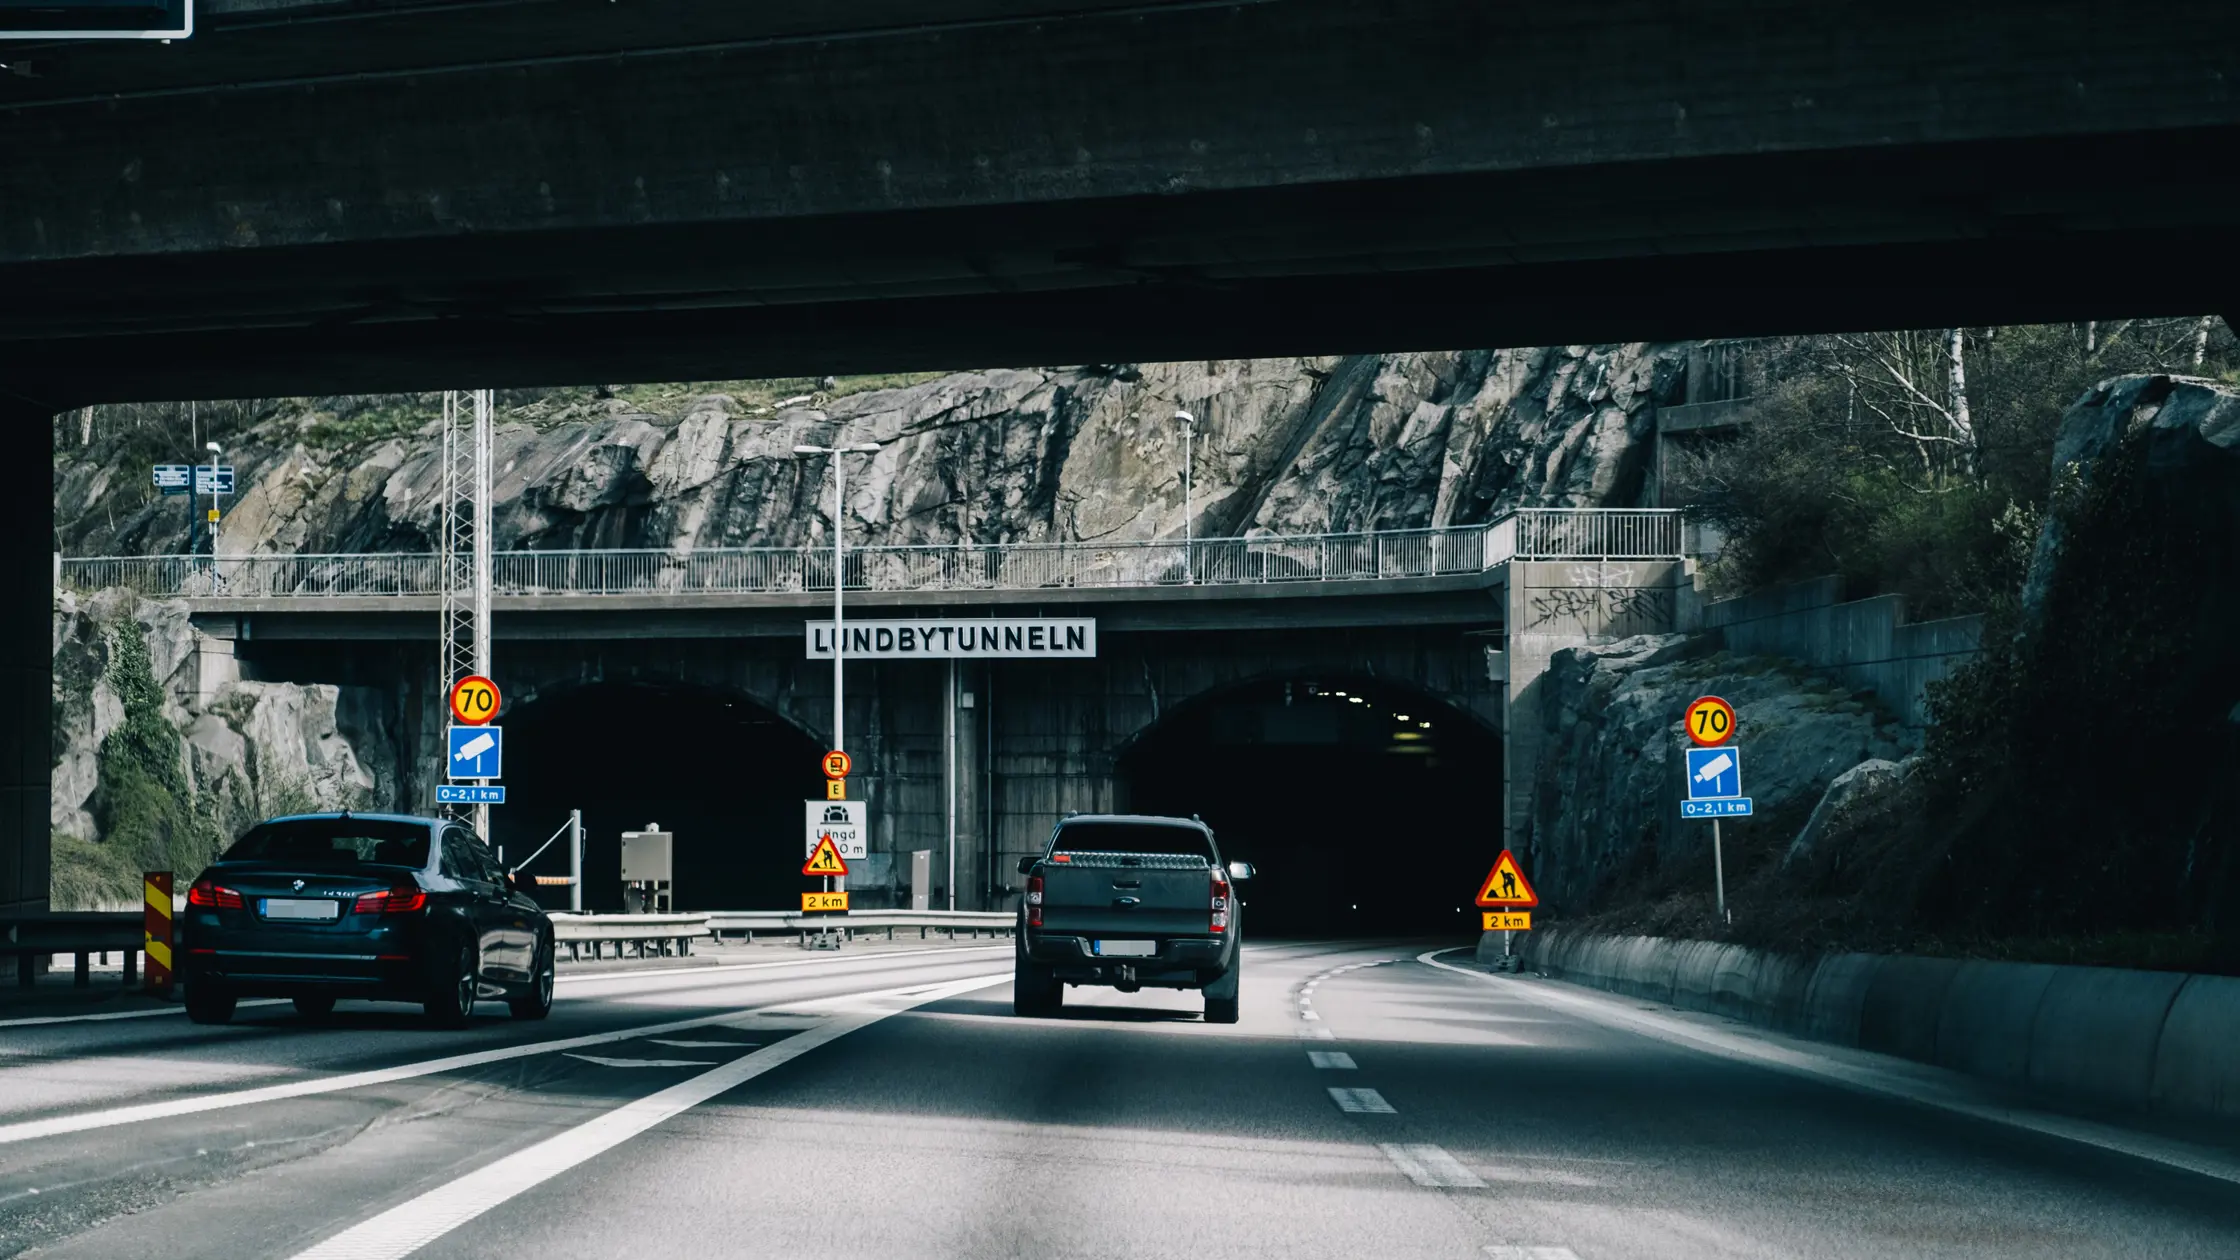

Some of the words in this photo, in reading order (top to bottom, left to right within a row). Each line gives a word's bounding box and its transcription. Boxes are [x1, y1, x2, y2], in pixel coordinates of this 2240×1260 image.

[815, 626, 1085, 652] LUNDBYTUNNELN
[461, 688, 493, 712] 70
[1695, 709, 1728, 734] 70
[441, 788, 476, 801] 0-2,1
[480, 789, 499, 800] km
[833, 784, 840, 795] E
[1686, 802, 1722, 815] 0-2,1
[1727, 802, 1747, 812] km
[853, 845, 864, 854] m
[808, 896, 817, 908] 2
[822, 896, 843, 908] km
[1490, 915, 1499, 928] 2
[1504, 916, 1524, 927] km
